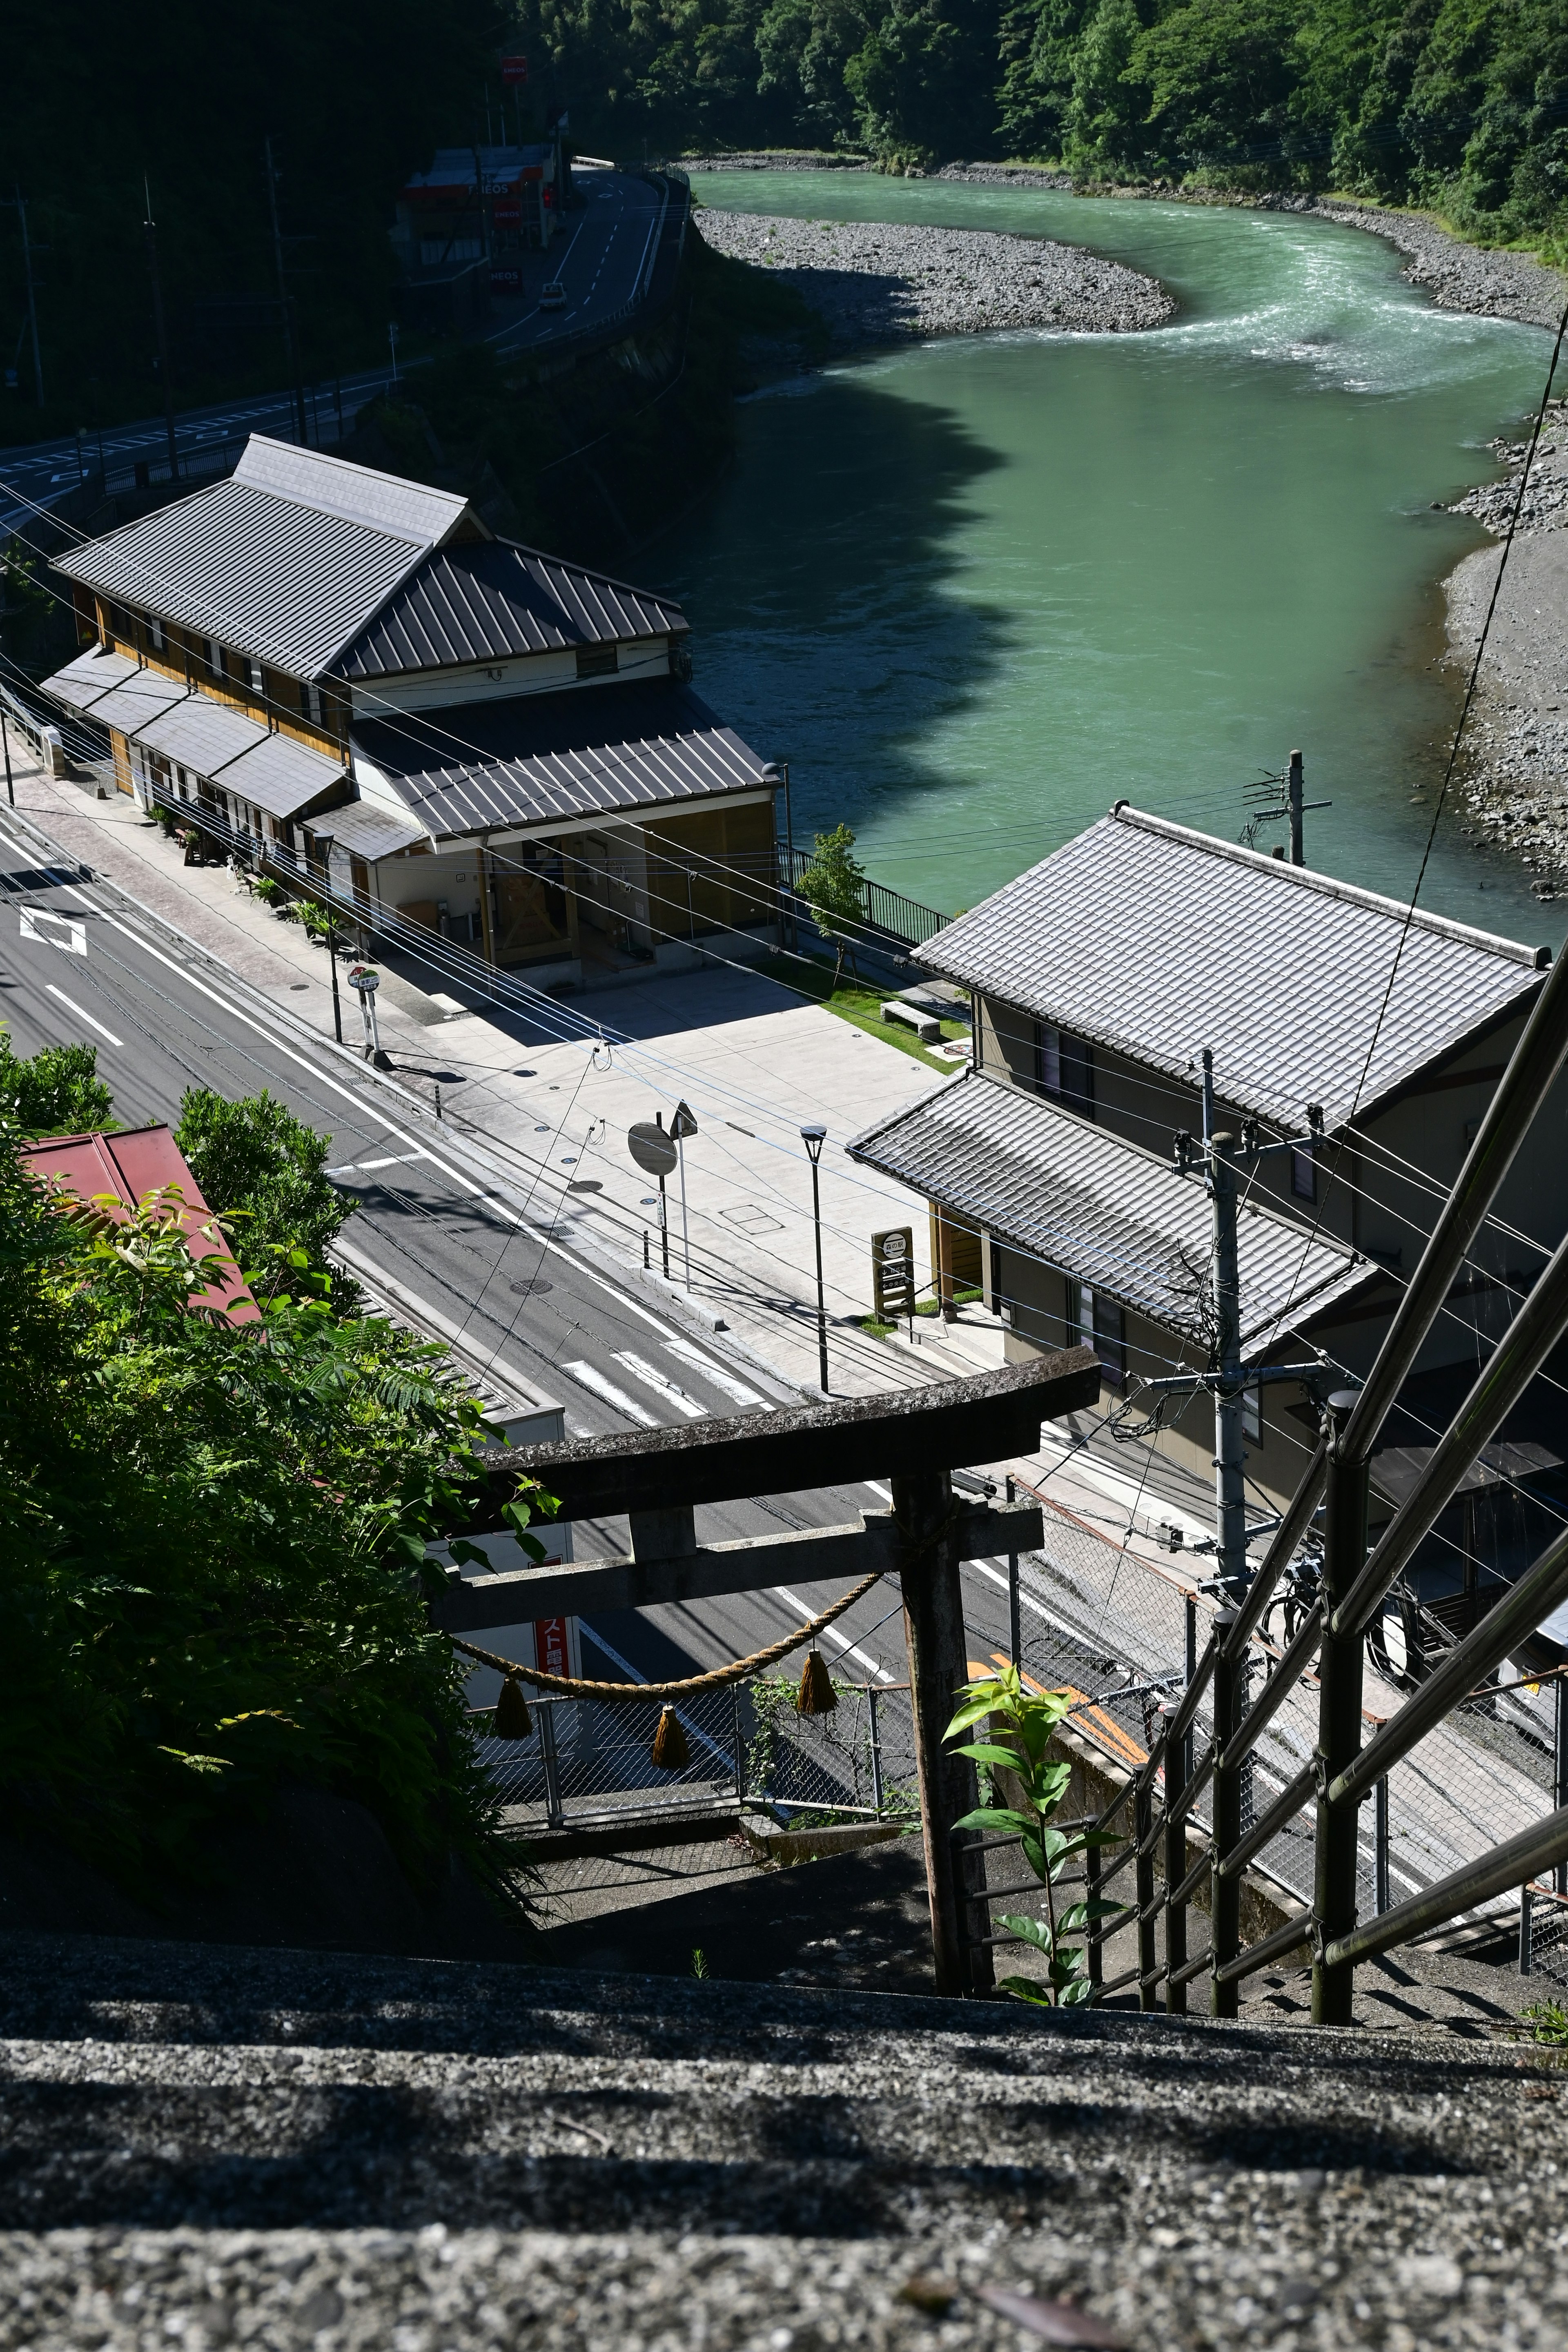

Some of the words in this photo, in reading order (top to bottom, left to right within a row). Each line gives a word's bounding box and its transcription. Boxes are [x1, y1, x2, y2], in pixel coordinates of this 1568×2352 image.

[489, 272, 518, 281] NEOS
[886, 1241, 903, 1250] 森の駅
